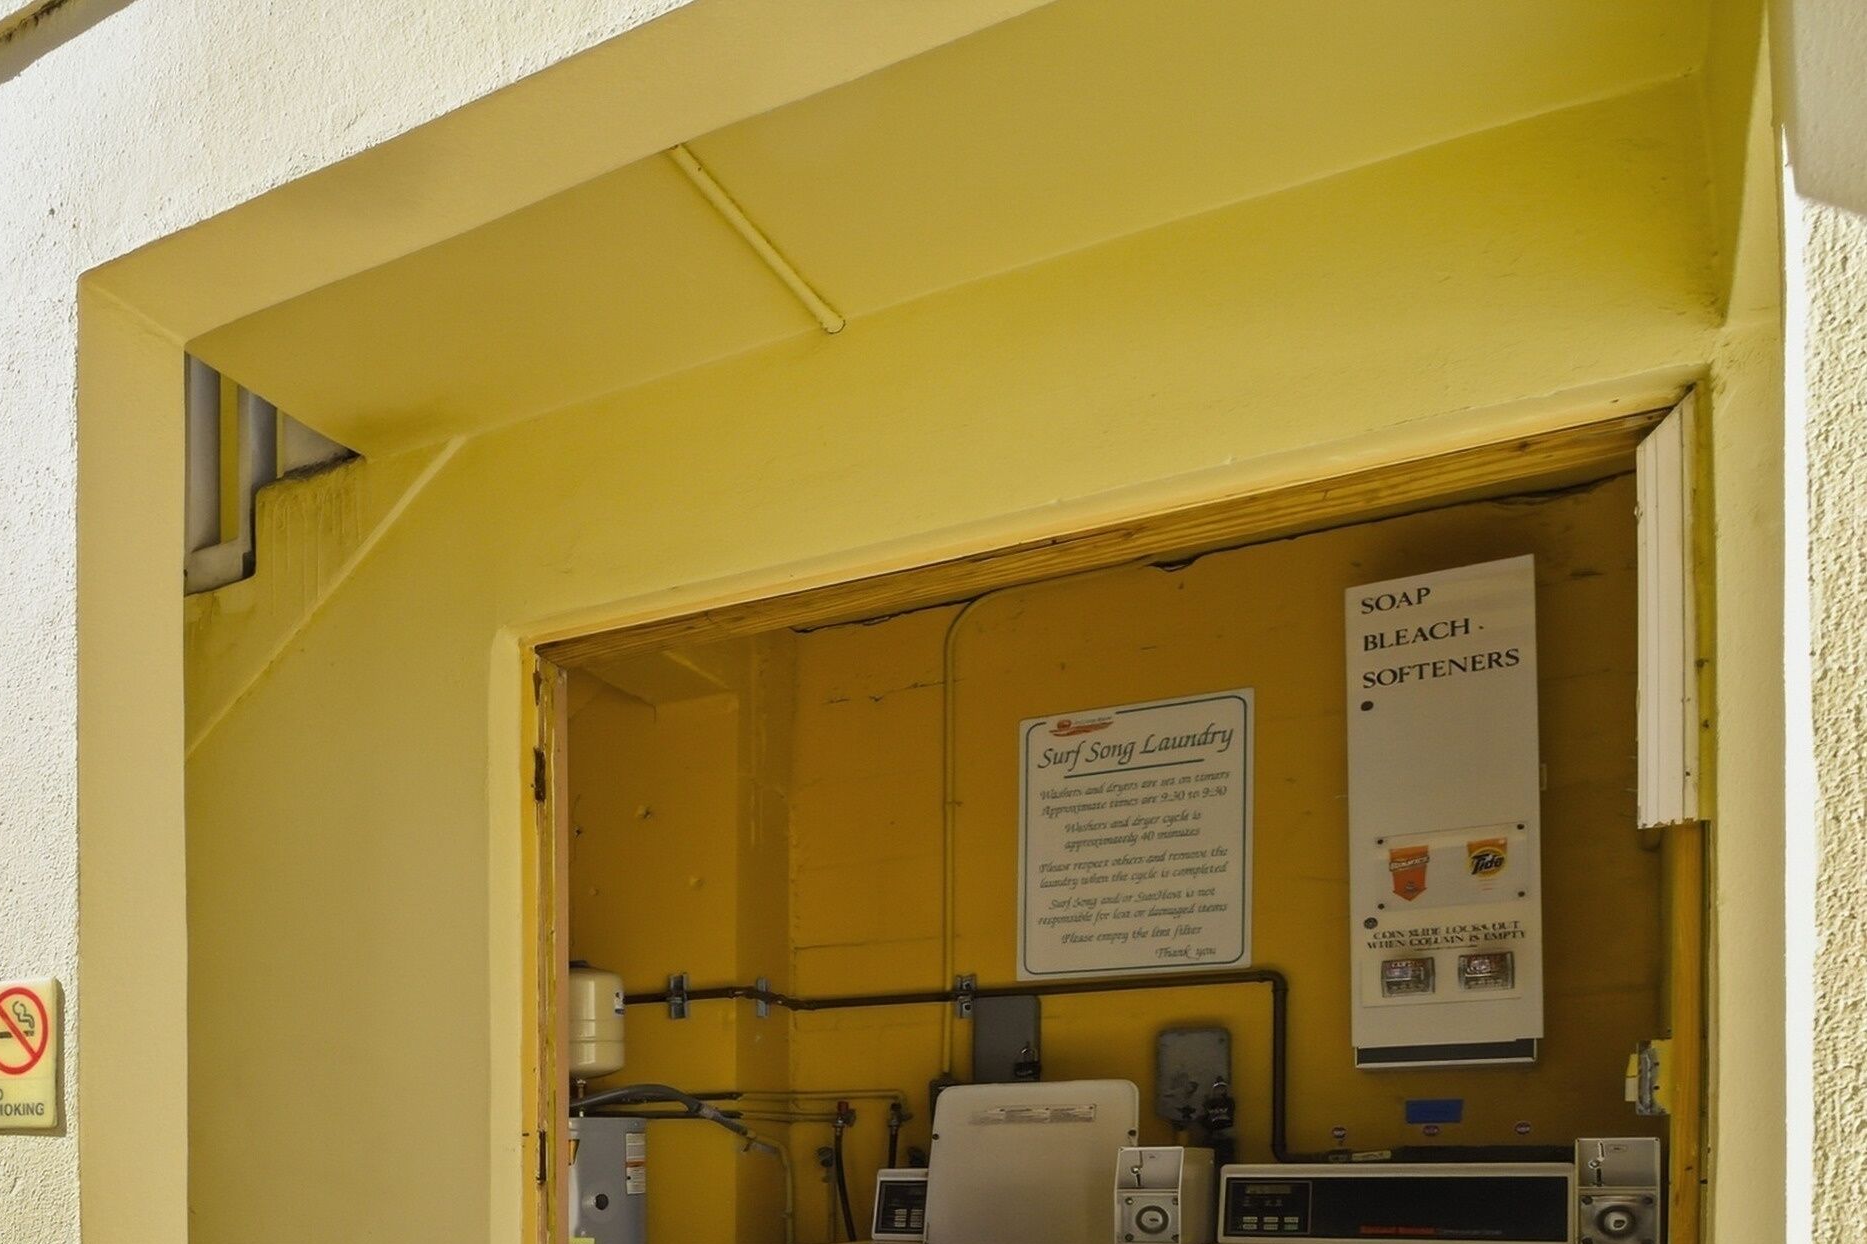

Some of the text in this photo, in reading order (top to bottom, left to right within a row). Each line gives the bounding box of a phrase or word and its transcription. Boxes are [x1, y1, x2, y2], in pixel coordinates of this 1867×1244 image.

[1361, 587, 1431, 614] SOAP
[1364, 618, 1470, 651] BLEACH
[1363, 648, 1519, 689] SOFTENERS
[1038, 723, 1233, 771] Surf Song Laundry
[1085, 785, 1103, 795] and
[1110, 819, 1128, 829] and
[1163, 811, 1188, 826] cycle
[1192, 811, 1201, 819] is
[1146, 853, 1165, 864] and
[1211, 847, 1227, 857] the
[1472, 854, 1504, 875] Tide
[1081, 874, 1109, 884] when
[1112, 871, 1128, 882] the
[1131, 869, 1156, 884] cycle
[1161, 868, 1169, 877] is
[1172, 861, 1228, 878] completed
[1048, 897, 1072, 910] Surf
[1073, 897, 1096, 909] Song
[1186, 889, 1194, 898] is
[1197, 887, 1215, 897] not
[1038, 911, 1092, 928] responsible
[1094, 909, 1109, 926] for
[1134, 909, 1145, 917] or
[1148, 902, 1194, 919] damaged
[1062, 932, 1093, 943] Please
[1132, 927, 1148, 938] the
[1367, 930, 1525, 949] WHEN COLUMN IS EMPTY
[1156, 945, 1190, 958] Thank
